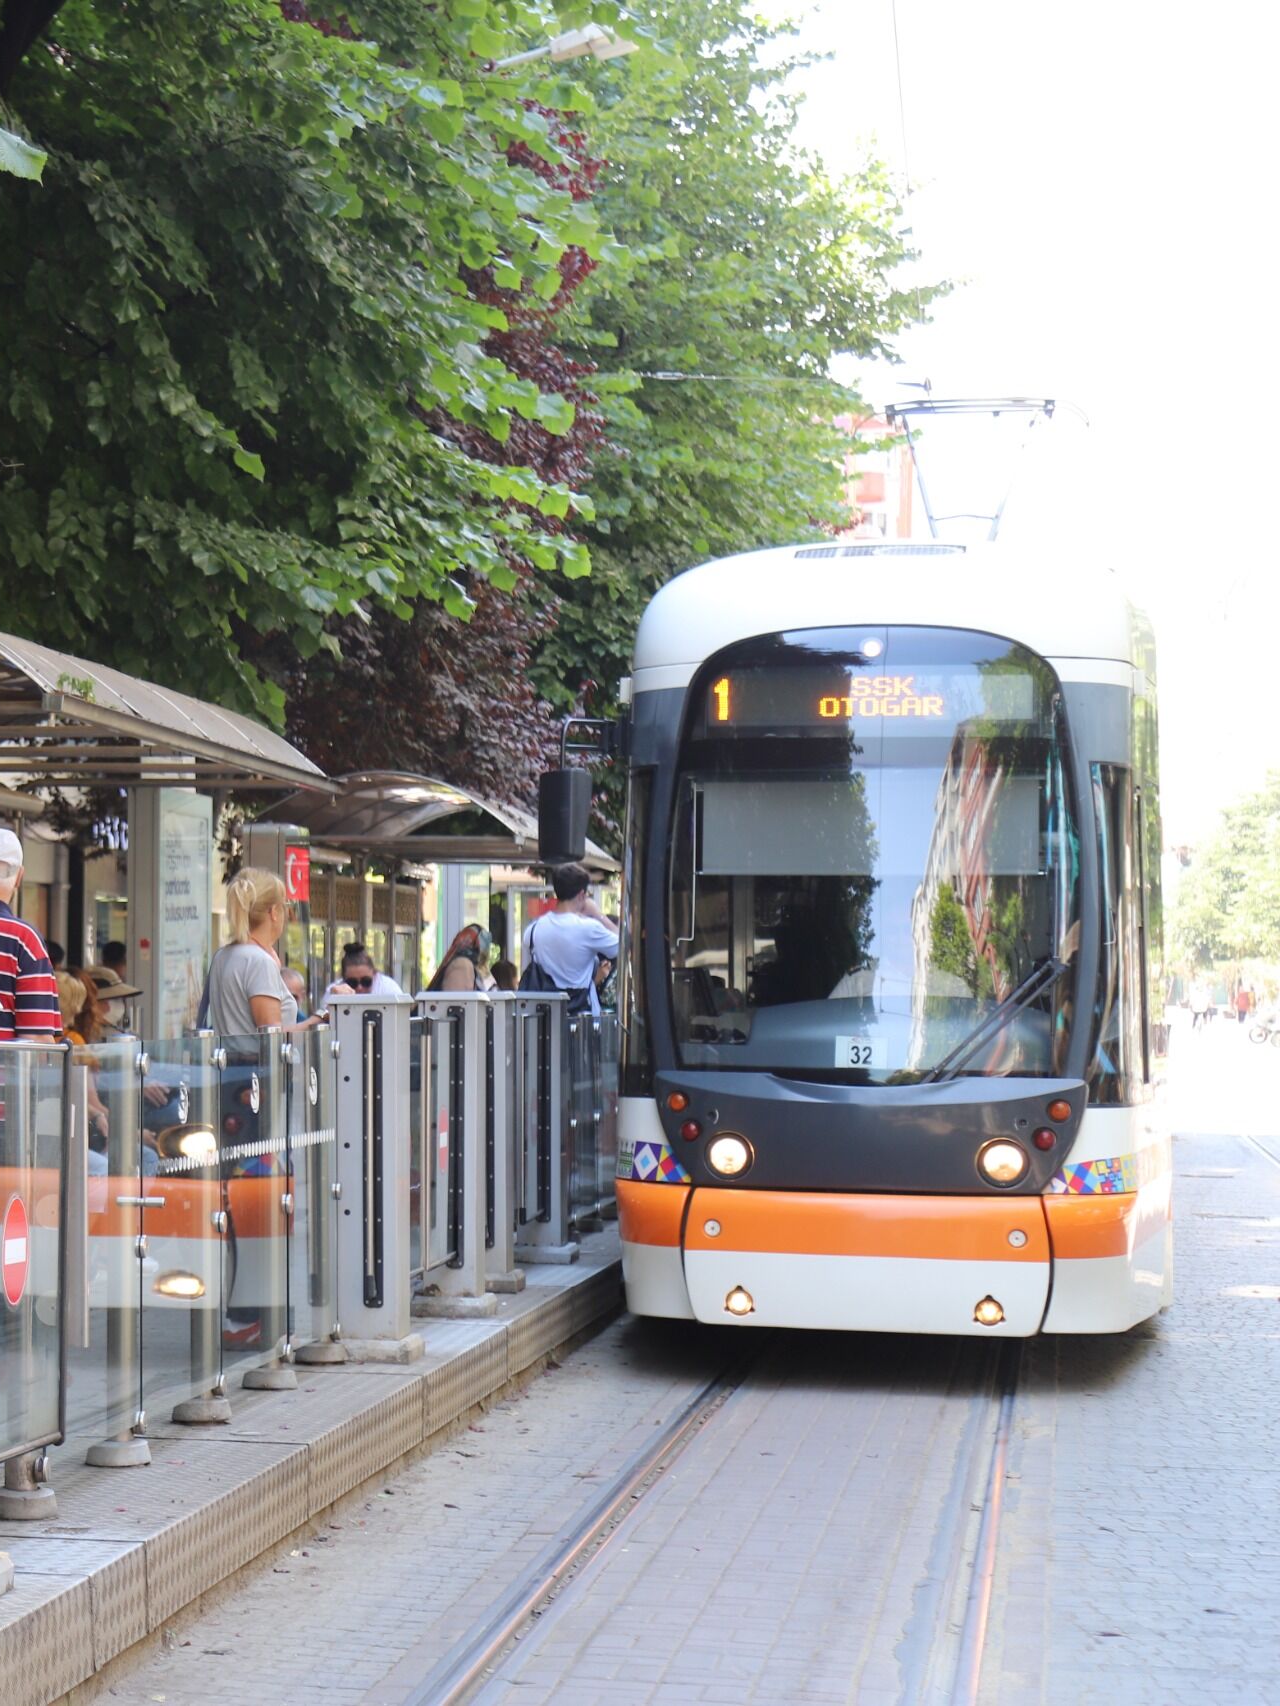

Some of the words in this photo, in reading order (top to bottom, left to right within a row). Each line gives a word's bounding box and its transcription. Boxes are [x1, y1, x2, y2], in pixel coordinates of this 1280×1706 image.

[714, 678, 730, 721] 1
[850, 676, 915, 696] SSK
[819, 697, 944, 718] OTOGAR
[850, 1045, 873, 1065] 32
